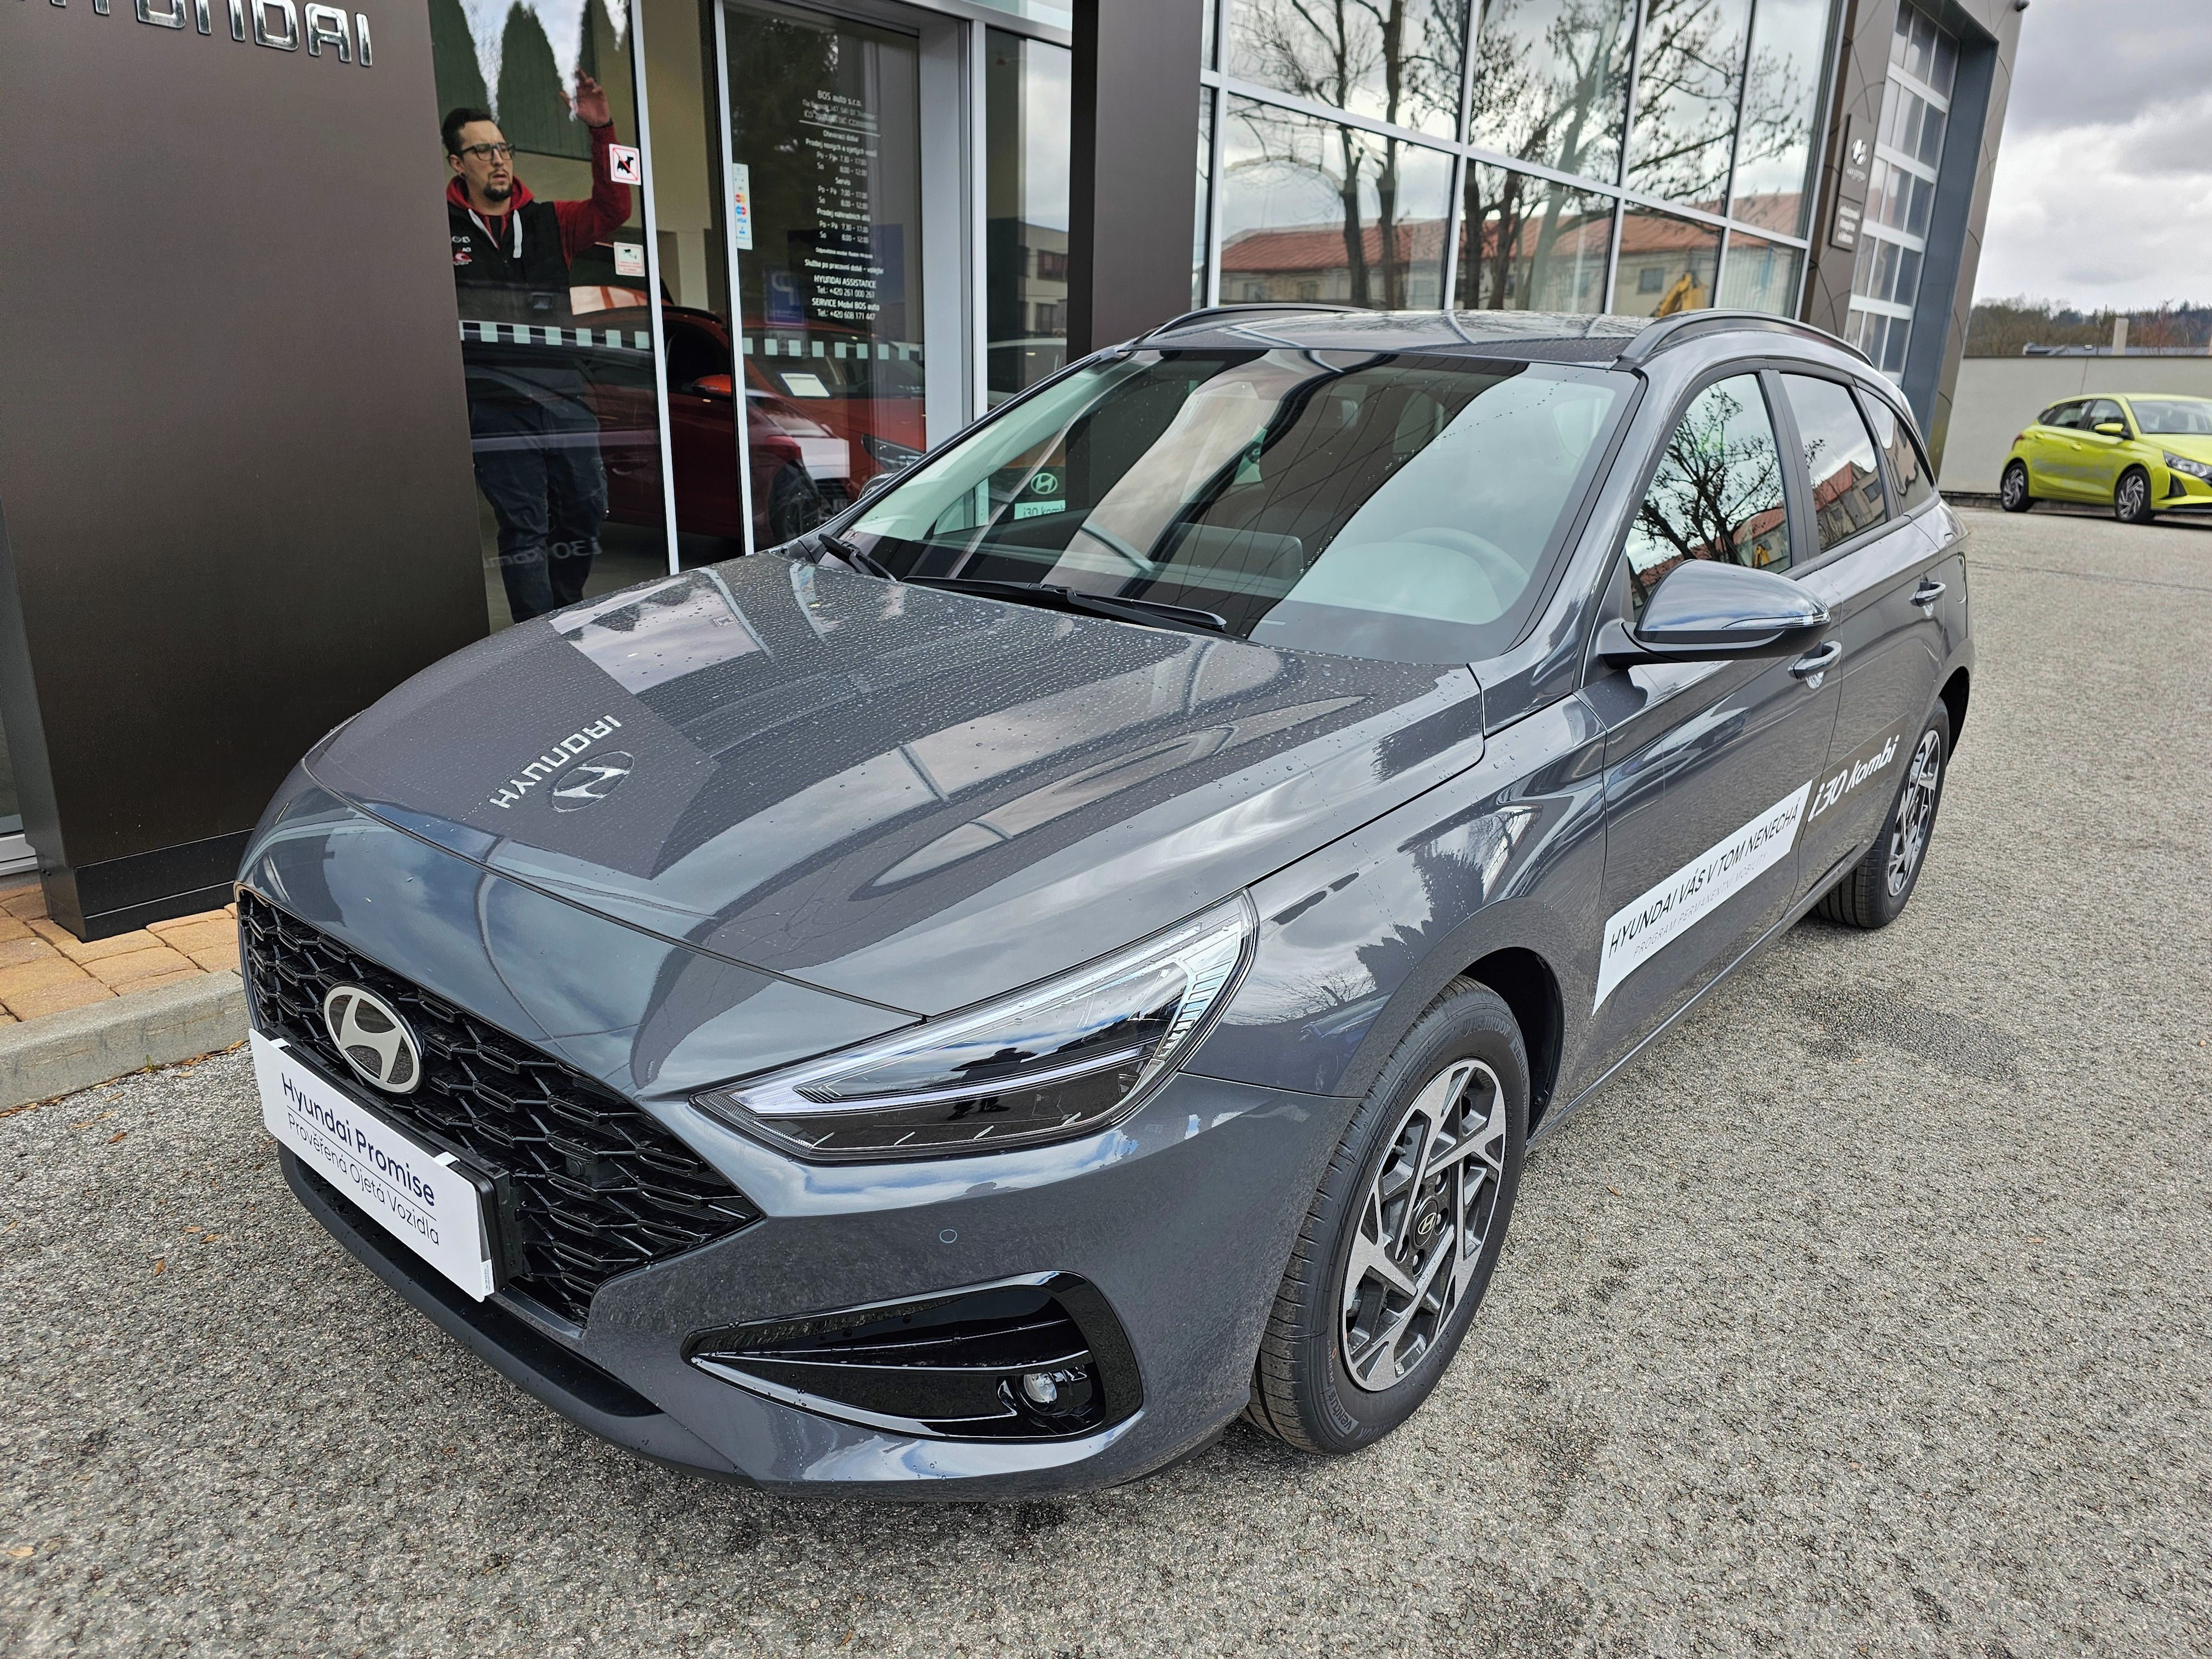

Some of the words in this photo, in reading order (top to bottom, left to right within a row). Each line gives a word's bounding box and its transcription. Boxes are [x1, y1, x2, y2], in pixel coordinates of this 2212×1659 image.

[811, 298, 837, 307] SERVICE
[837, 300, 853, 309] Mobil
[813, 275, 842, 285] HYUNDAI
[842, 278, 877, 289] ASSISTANCE
[489, 714, 623, 809] HYUNDAI
[1807, 782, 1848, 822] i30
[1844, 734, 1900, 794] kombi
[1608, 888, 1678, 958] HYUNDAI
[1678, 868, 1707, 904] VÁS
[1717, 840, 1746, 877] TOM
[1745, 796, 1801, 857] NENECHÁ
[281, 1072, 353, 1147] Hyundai
[356, 1128, 435, 1207] Promise
[288, 1112, 348, 1175] Prověřená
[349, 1163, 385, 1205] Ojetá
[387, 1190, 439, 1246] Vozidla
